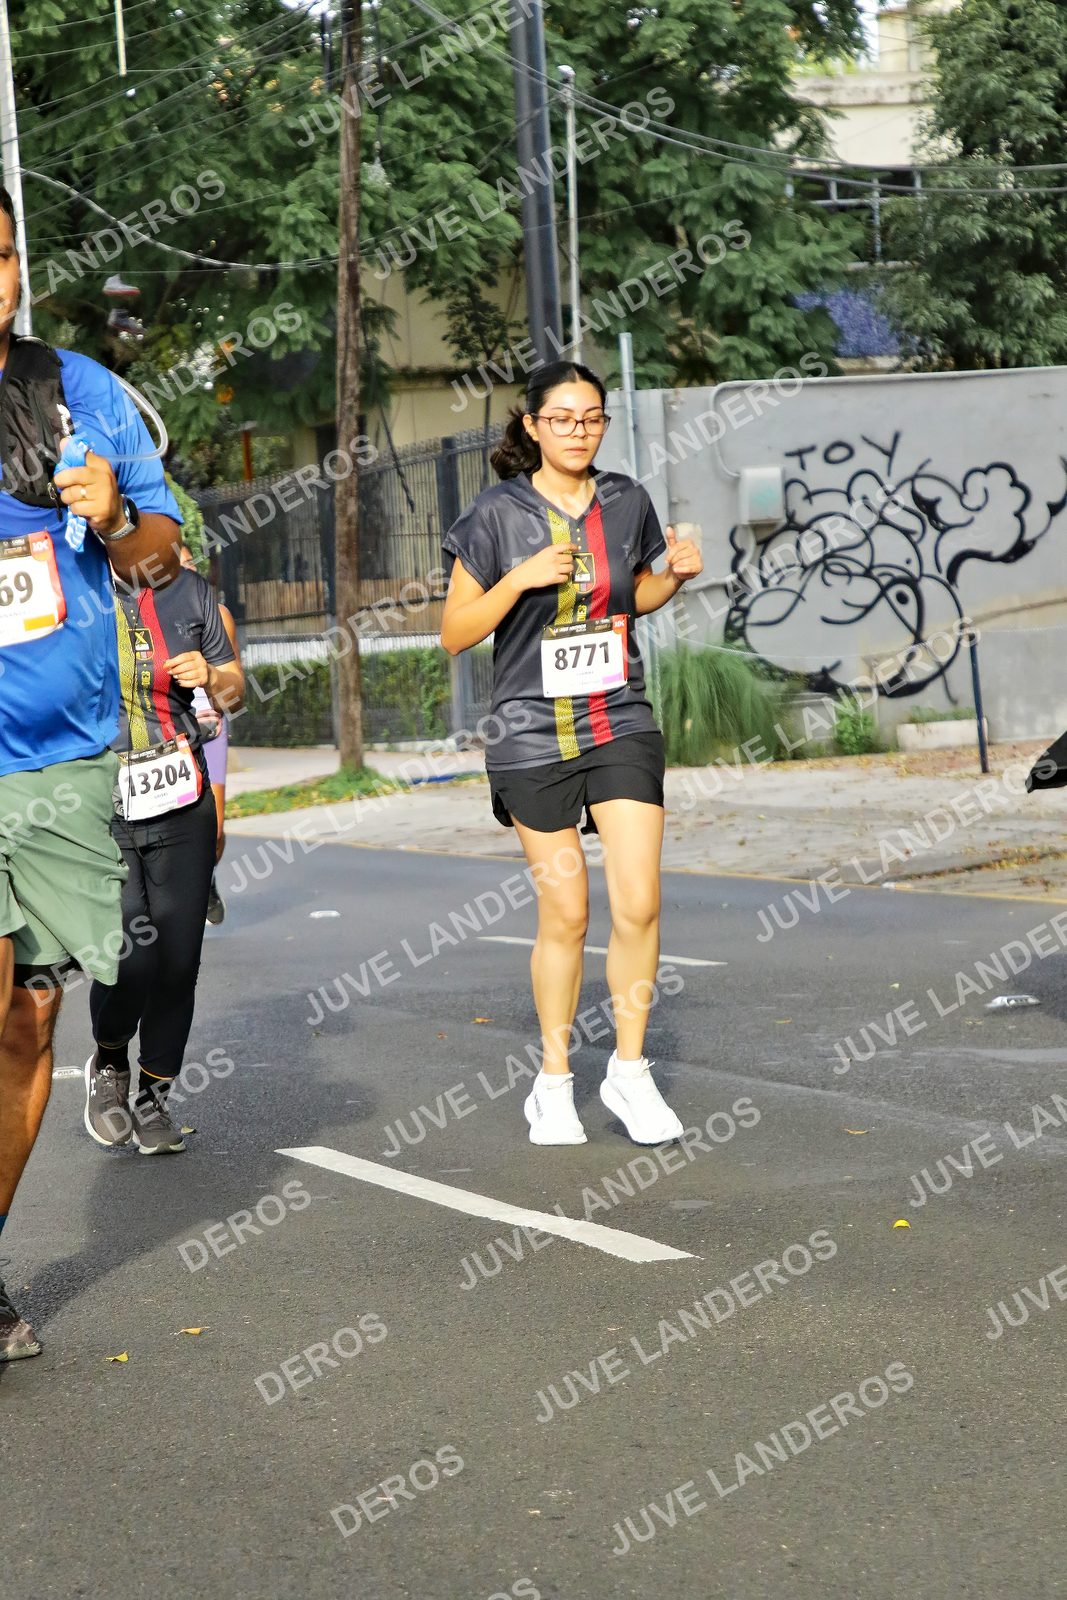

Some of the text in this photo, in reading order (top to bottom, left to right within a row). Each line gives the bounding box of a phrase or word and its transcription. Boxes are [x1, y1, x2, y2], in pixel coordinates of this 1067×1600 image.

[785, 430, 900, 477] TOY
[554, 641, 610, 671] 8771
[124, 759, 192, 797] 13204
